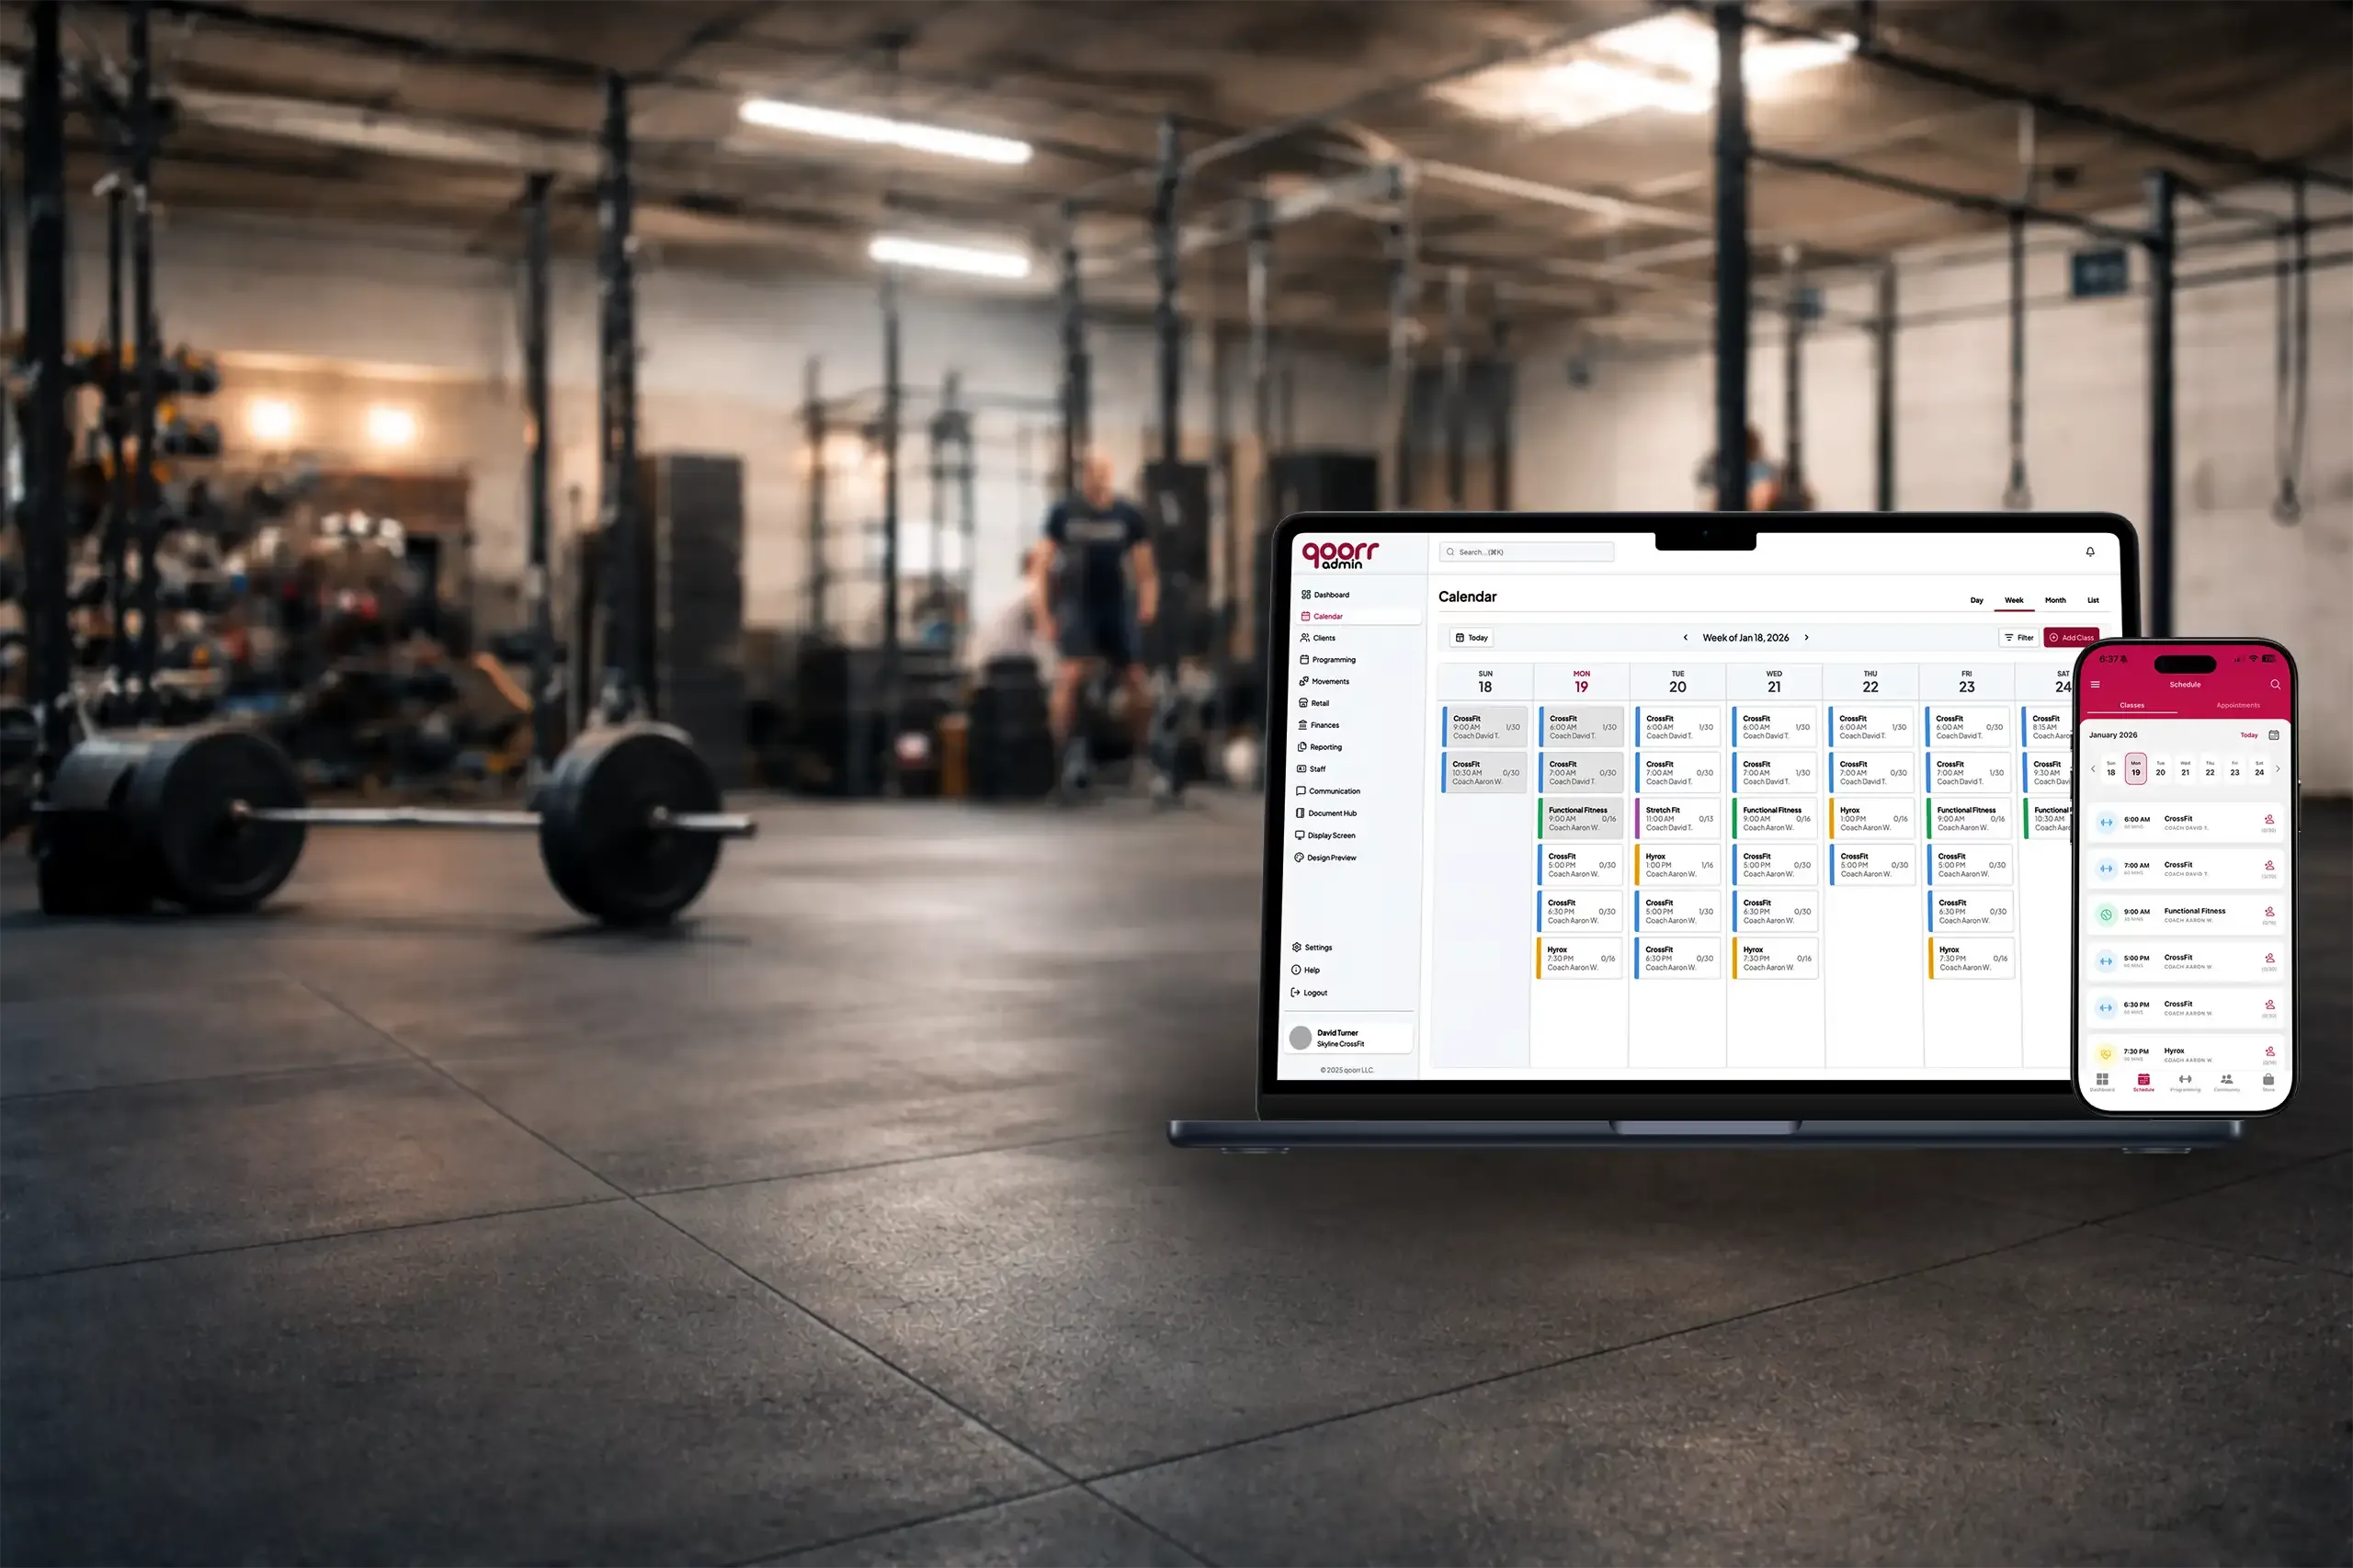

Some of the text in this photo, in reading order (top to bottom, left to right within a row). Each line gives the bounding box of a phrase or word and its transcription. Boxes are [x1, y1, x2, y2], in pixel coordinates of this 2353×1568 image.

[1302, 542, 1380, 569] qoorr
[1323, 560, 1362, 569] admin
[1439, 591, 1497, 602] Calendar
[1970, 597, 1984, 606] Day
[1313, 612, 1344, 620] Calendar
[1469, 634, 1488, 642] Today
[1702, 633, 1790, 642] Week of Jan 18, 2026
[2018, 633, 2034, 642] Filter
[2077, 634, 2096, 642] Class
[1313, 656, 1356, 665] Programming
[2098, 654, 2119, 664] 6:37
[1312, 677, 1350, 686] Movements
[1479, 681, 1492, 692] 18
[1575, 681, 1588, 692] 19
[1670, 681, 1687, 692] 20
[1768, 681, 1780, 692] 21
[1863, 681, 1878, 692] 22
[1960, 681, 1974, 692] 23
[2055, 681, 2073, 693] 24
[2216, 701, 2261, 710] Appointments
[1452, 714, 1482, 722] CrossFit
[1549, 714, 1578, 722] CrossFit
[1646, 714, 1675, 722] CrossFit
[1742, 714, 1771, 722] CrossFit
[1838, 714, 1868, 722] CrossFit
[1935, 714, 1964, 722] CrossFit
[2032, 714, 2061, 722] CrossFit
[1310, 721, 1340, 729] Finances
[1506, 723, 1521, 732] 1/30
[2088, 731, 2137, 740] January 2026
[2240, 732, 2259, 740] Today
[1311, 744, 1342, 752] Reporting
[1452, 760, 1481, 768] CrossFit
[1549, 760, 1577, 768] CrossFit
[1645, 760, 1675, 768] CrossFit
[1743, 760, 1771, 768] CrossFit
[1839, 760, 1868, 768] CrossFit
[1936, 760, 1965, 768] CrossFit
[2033, 760, 2062, 768] CrossFit
[1309, 765, 1326, 773] Staff
[1452, 768, 1471, 777] 10:30
[1502, 768, 1520, 778] 0/30
[2107, 768, 2116, 777] 18
[2131, 768, 2142, 777] 19
[2155, 768, 2166, 777] 20
[2181, 768, 2189, 777] 21
[2205, 768, 2215, 777] 22
[2230, 768, 2240, 777] 23
[2255, 768, 2265, 777] 24
[1308, 787, 1361, 795] Communication
[1308, 809, 1342, 817] Document
[1549, 806, 1608, 814] Functional Fitness
[1645, 806, 1670, 814] Stretch
[1743, 806, 1802, 814] Functional Fitness
[1839, 806, 1860, 815] Hyrox
[1937, 806, 1995, 814] Functional Fitness
[2034, 806, 2069, 814] Functional
[2164, 814, 2193, 823] CrossFit
[1308, 831, 1356, 840] Display Screen
[1307, 854, 1357, 863] Design Preview
[1548, 852, 1576, 860] CrossFit
[1645, 852, 1666, 861] Hyrox
[1743, 852, 1771, 860] CrossFit
[1840, 852, 1869, 860] CrossFit
[1938, 852, 1966, 860] CrossFit
[2164, 860, 2193, 869] CrossFit
[1547, 899, 1576, 907] CrossFit
[1645, 899, 1674, 907] CrossFit
[1743, 899, 1772, 907] CrossFit
[1938, 899, 1967, 907] CrossFit
[1305, 944, 1332, 952] Settings
[1547, 946, 1568, 955] Hyrox
[1645, 945, 1674, 954] CrossFit
[1743, 946, 1764, 955] Hyrox
[1938, 946, 1960, 955] Hyrox
[2164, 953, 2193, 961] CrossFit
[1303, 966, 1321, 975] Help
[1303, 989, 1328, 998] Logout
[1317, 1028, 1358, 1037] David Turner
[1316, 1040, 1364, 1049] Skyline CrossFit
[2164, 1047, 2185, 1056] Hyrox
[1326, 1066, 1343, 1074] 2025
